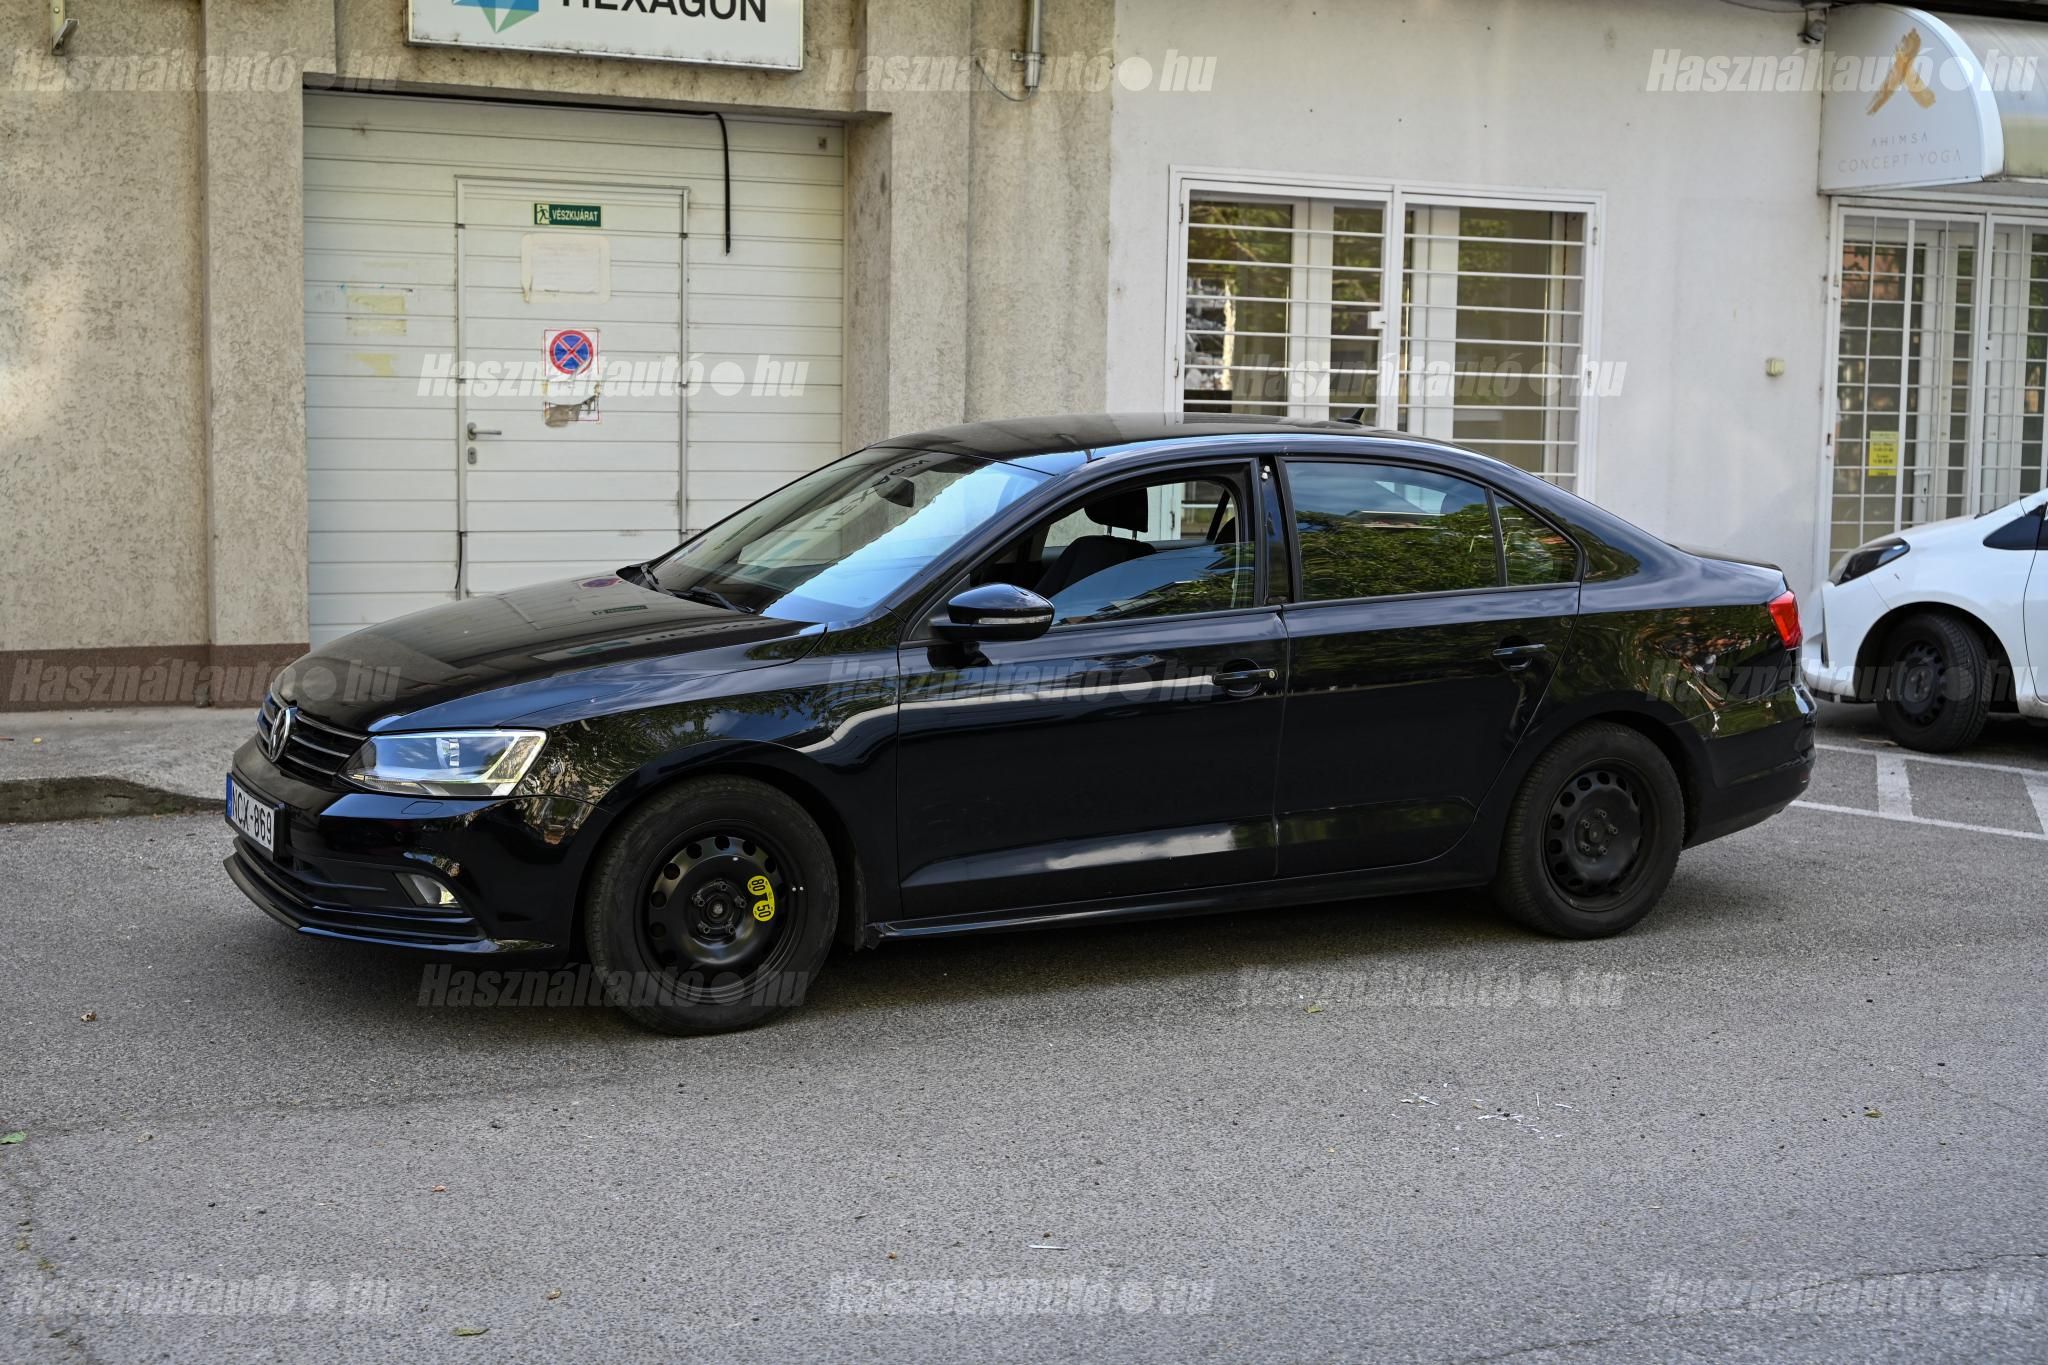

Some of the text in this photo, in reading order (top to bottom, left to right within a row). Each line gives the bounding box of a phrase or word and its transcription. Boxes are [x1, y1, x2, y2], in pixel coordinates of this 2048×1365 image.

[1838, 149, 1961, 173] CONCEPT YOGA
[552, 208, 598, 221] VÉSZKIJÁRAT
[752, 879, 765, 891] 80
[757, 904, 771, 918] 50
